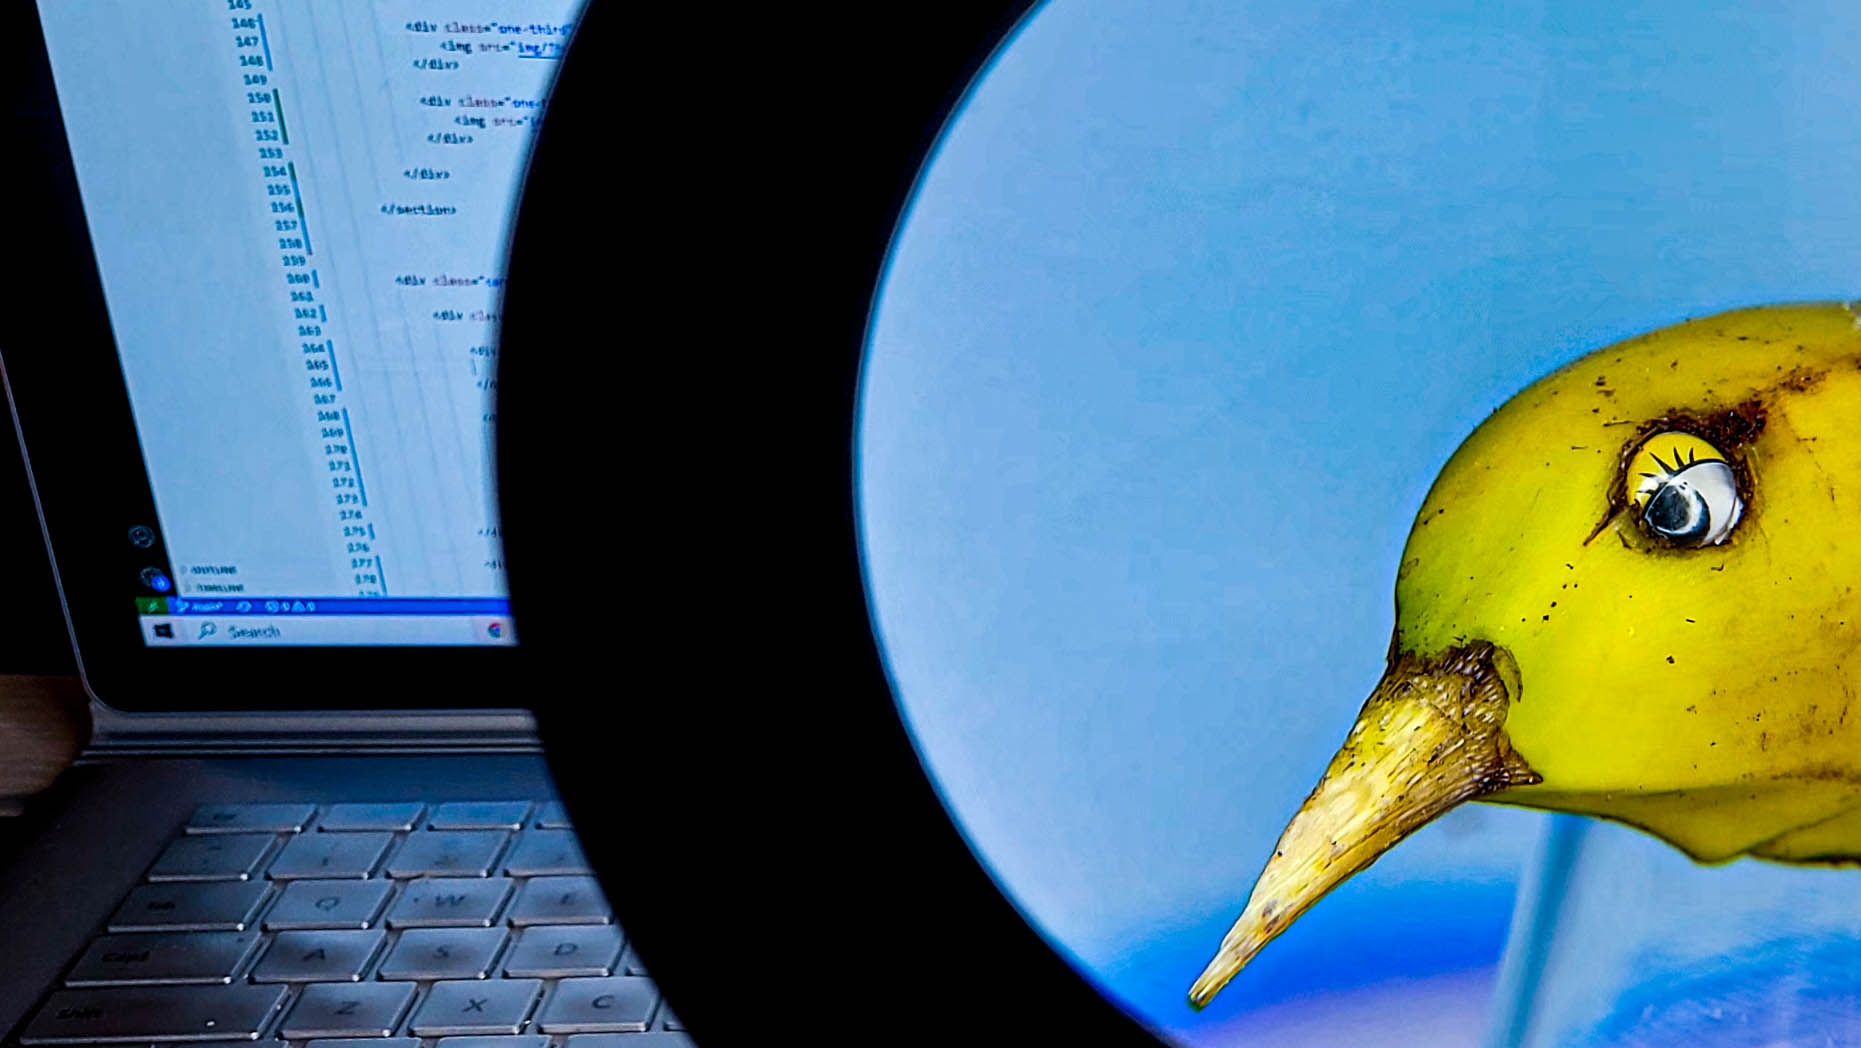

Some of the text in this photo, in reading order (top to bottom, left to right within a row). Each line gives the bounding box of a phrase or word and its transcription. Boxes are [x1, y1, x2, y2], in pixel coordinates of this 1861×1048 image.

[227, 624, 280, 640] Search
[315, 896, 341, 912] Q
[434, 894, 466, 908] W
[303, 946, 327, 962] A
[434, 945, 452, 960] S
[553, 941, 579, 957] D
[336, 1000, 359, 1016] Z
[462, 996, 487, 1013] X
[592, 994, 618, 1010] C
